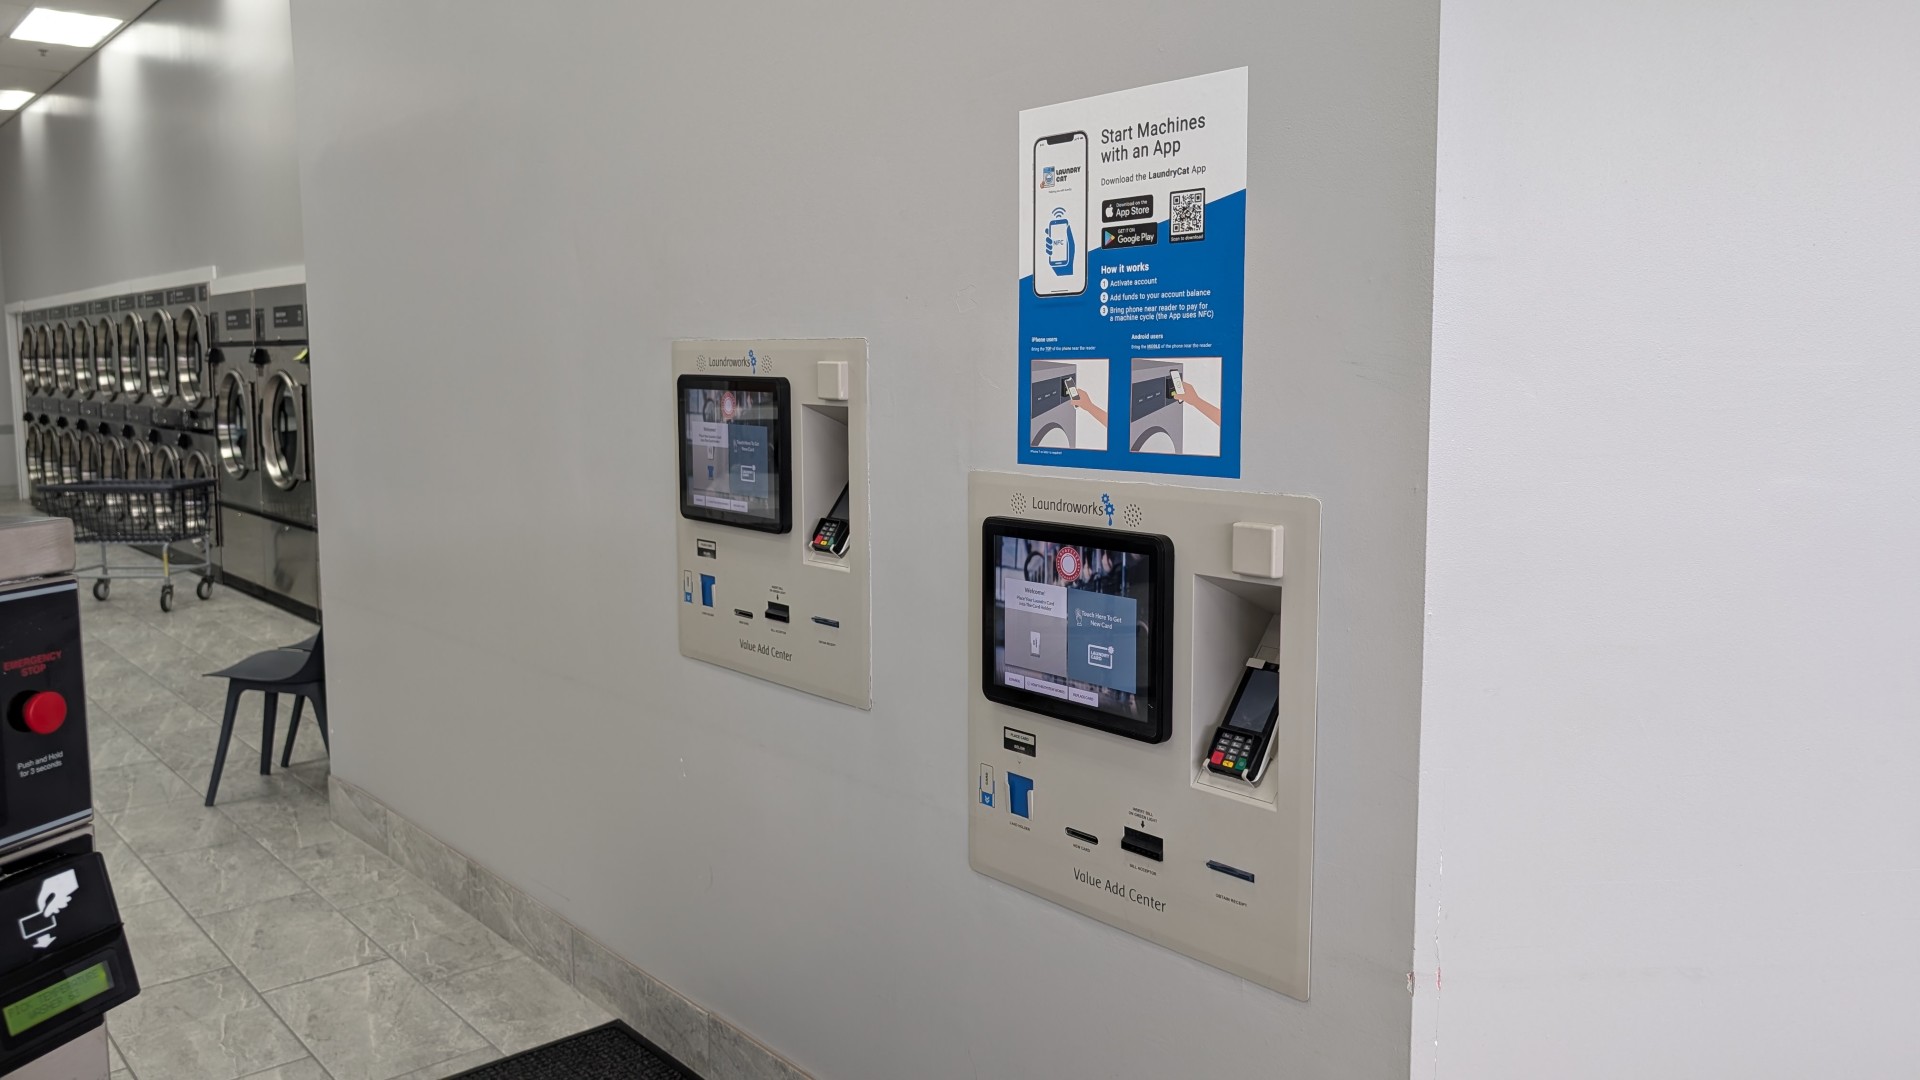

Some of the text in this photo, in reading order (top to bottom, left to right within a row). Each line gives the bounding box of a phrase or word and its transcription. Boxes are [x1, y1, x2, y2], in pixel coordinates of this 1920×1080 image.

[1101, 116, 1205, 144] Start Machines
[1101, 140, 1180, 163] with an App
[1056, 166, 1082, 176] LAUNDRY
[1101, 165, 1206, 186] Download the LaundryCat App
[1116, 206, 1150, 217] App Store
[1118, 232, 1154, 244] Google Play
[1101, 262, 1150, 274] How it works
[1110, 279, 1133, 287] Activate
[1134, 278, 1158, 286] account
[1146, 292, 1160, 300] your
[1161, 290, 1185, 298] account
[1186, 289, 1211, 297] balance
[1110, 306, 1124, 314] Bring
[1126, 306, 1143, 314] phone
[1158, 304, 1178, 312] reader
[1186, 304, 1198, 312] pay
[1140, 313, 1154, 322] cycle
[1156, 312, 1168, 320] (the
[1169, 312, 1180, 320] App
[1198, 310, 1214, 319] NFC)
[708, 356, 750, 368] Laundroworks
[1032, 496, 1104, 516] Laundroworks
[1095, 612, 1107, 620] Here
[740, 638, 792, 662] Value Add Center
[3, 650, 62, 671] EMERGENCY
[21, 664, 46, 676] STOP
[18, 750, 64, 770] Push and Hold
[36, 760, 62, 773] seconds
[1074, 867, 1166, 912] Value Add Center
